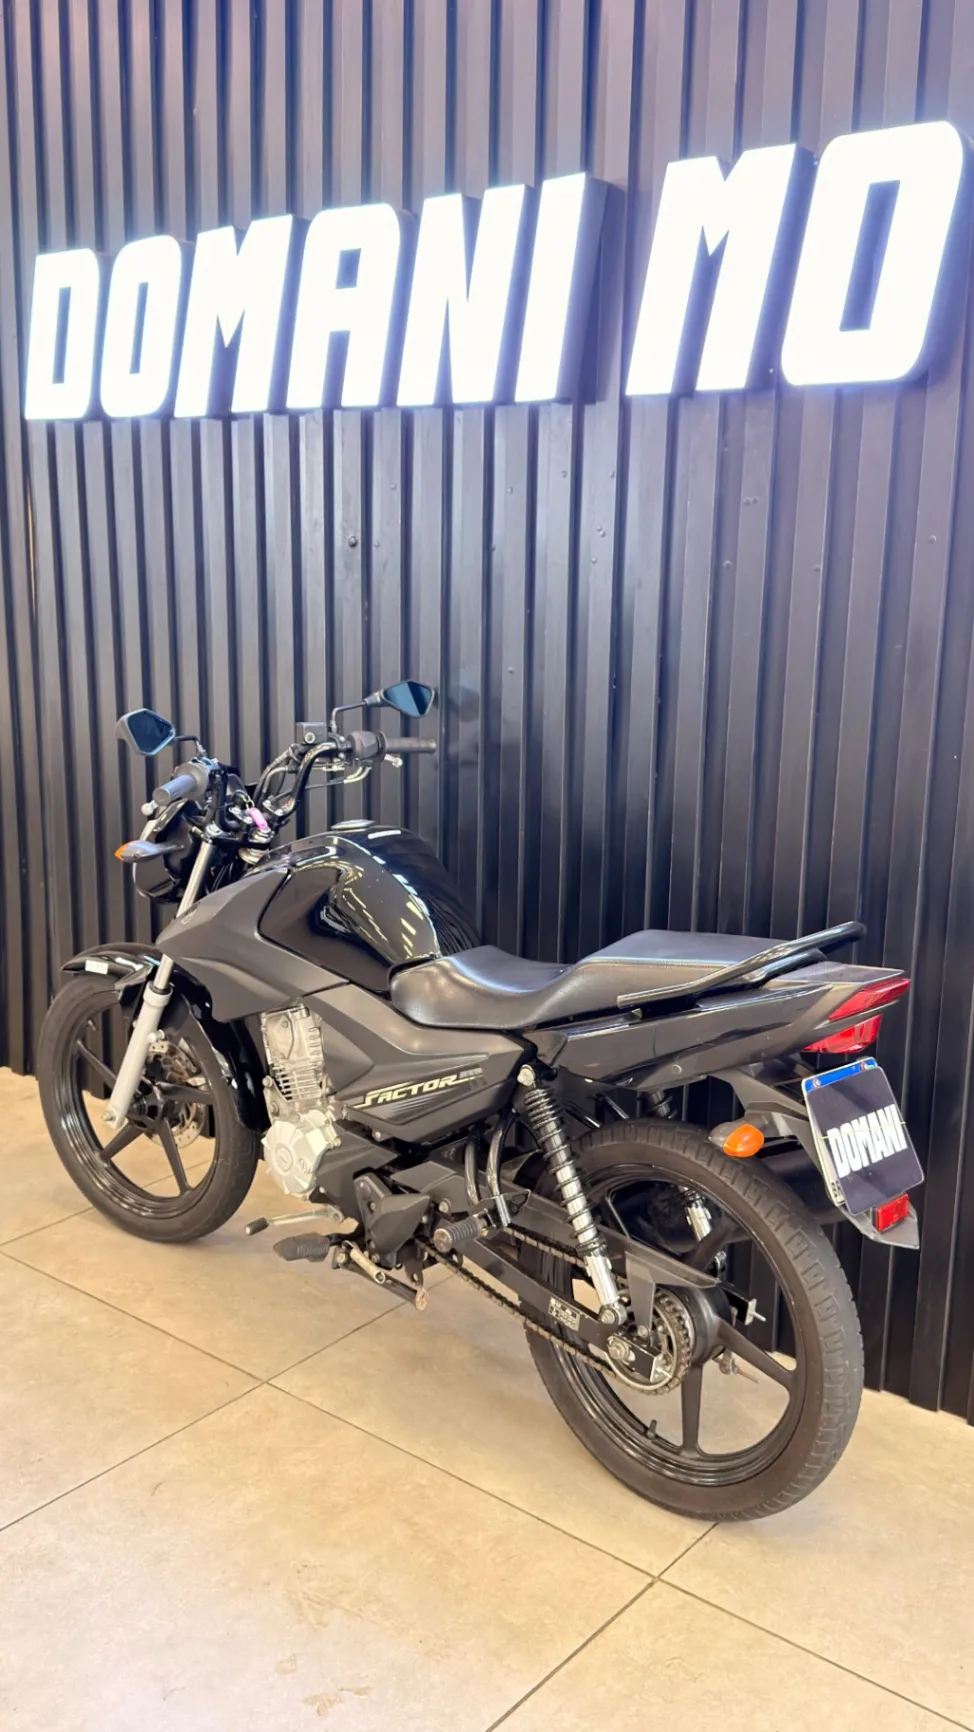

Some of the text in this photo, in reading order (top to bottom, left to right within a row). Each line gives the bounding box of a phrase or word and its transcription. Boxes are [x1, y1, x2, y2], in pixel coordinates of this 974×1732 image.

[24, 120, 964, 420] DOMANI MO
[353, 1074, 474, 1109] FACTOR
[827, 1104, 908, 1178] DOMANI
